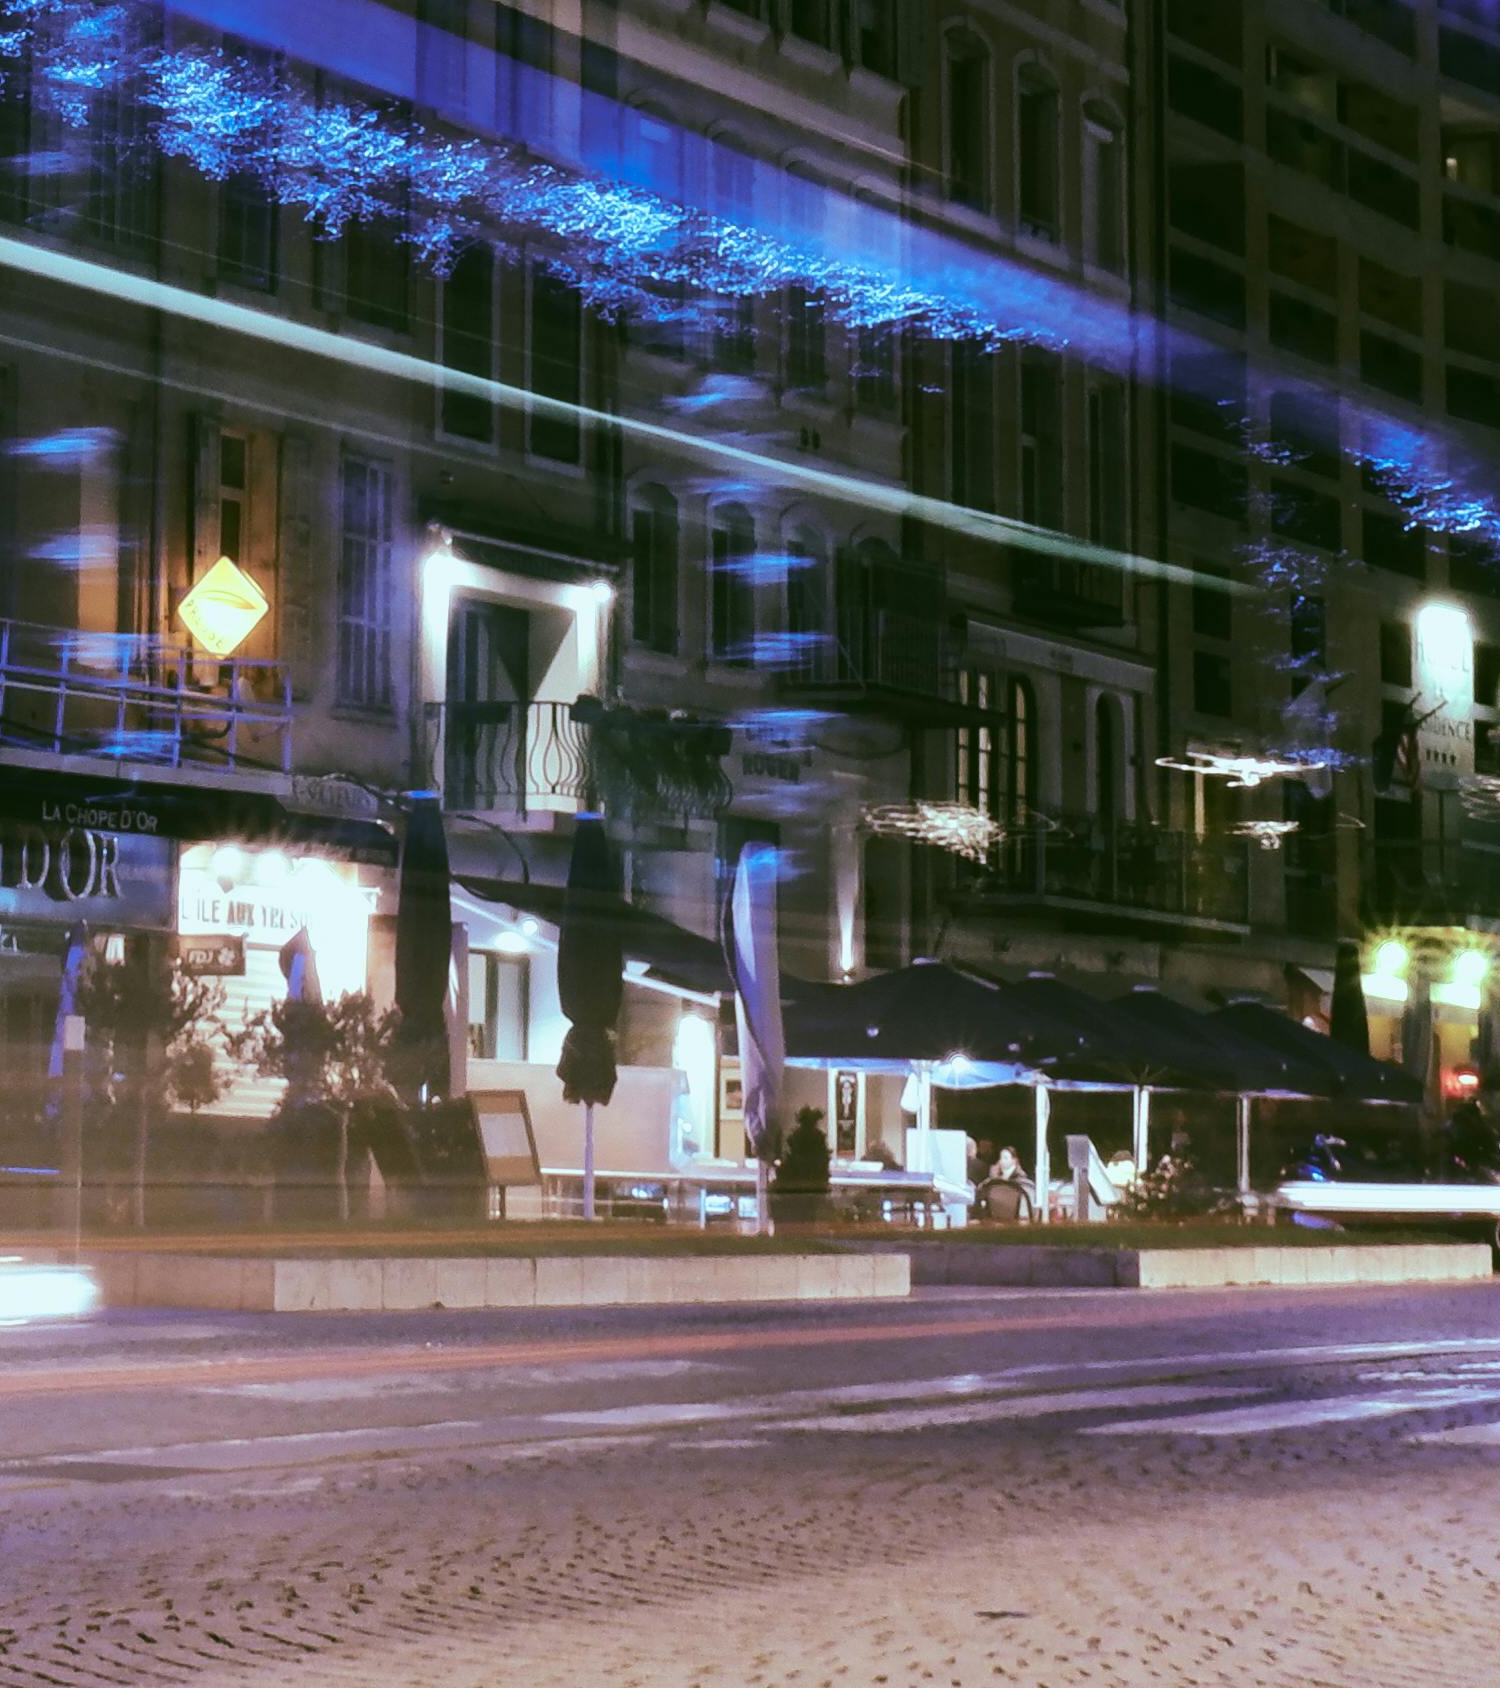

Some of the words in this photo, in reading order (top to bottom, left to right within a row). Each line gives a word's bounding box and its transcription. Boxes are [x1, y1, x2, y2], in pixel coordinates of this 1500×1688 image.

[42, 800, 60, 821] LA
[65, 803, 117, 829] CHOPE
[18, 826, 124, 902] DOR
